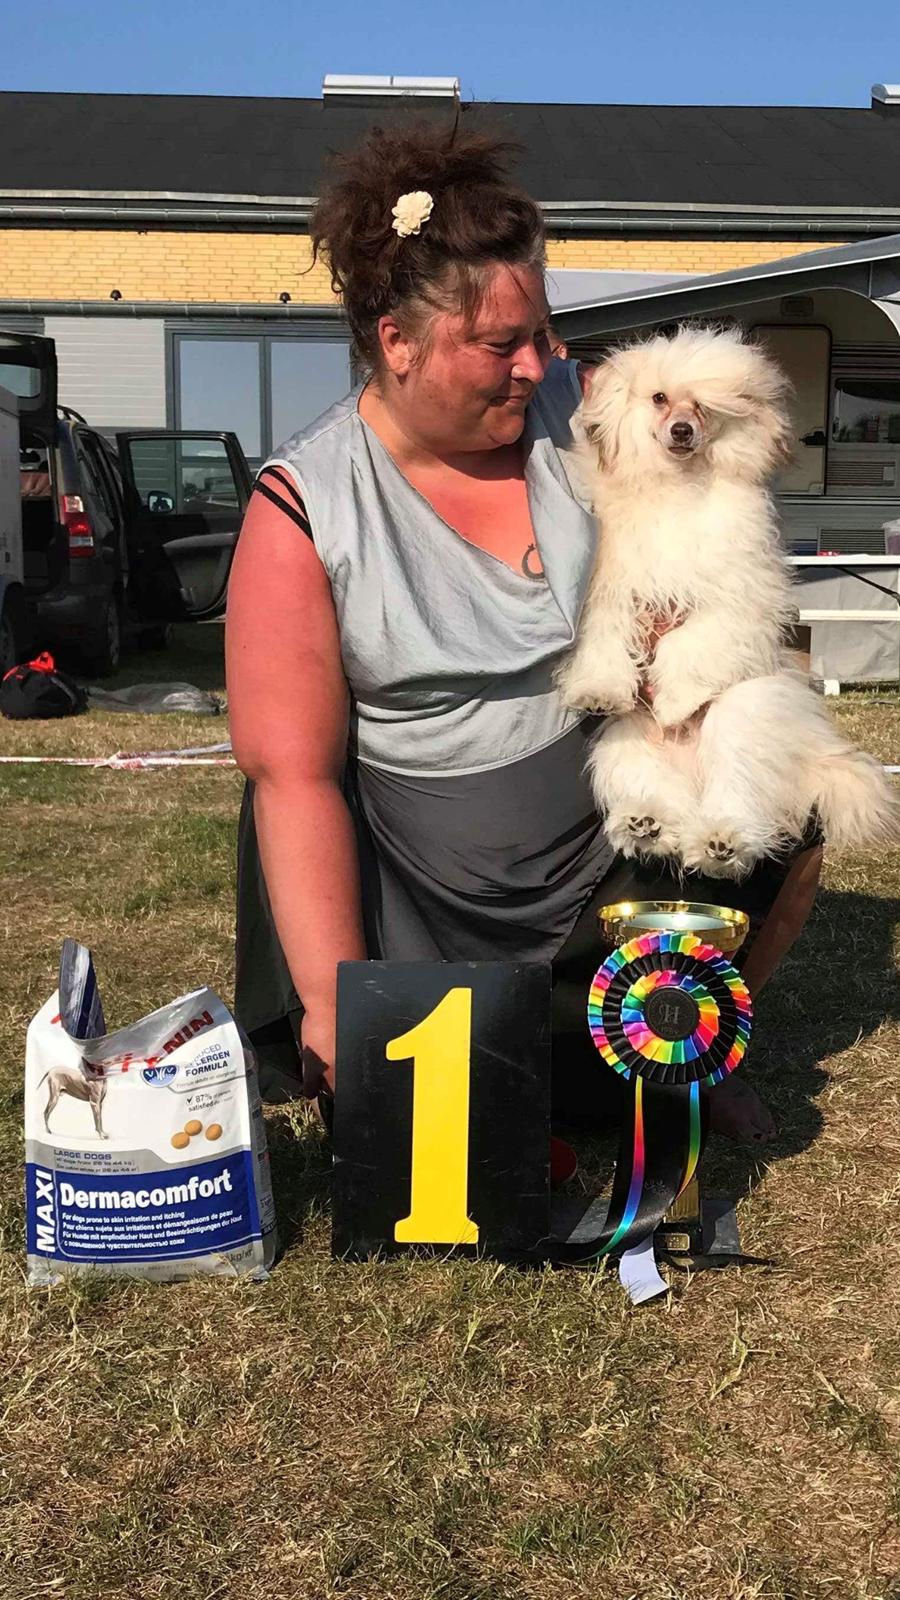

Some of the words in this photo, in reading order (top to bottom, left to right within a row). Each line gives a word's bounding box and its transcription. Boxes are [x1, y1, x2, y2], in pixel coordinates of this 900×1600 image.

[185, 1060, 228, 1076] FORMULA
[386, 988, 479, 1243] 1
[54, 1149, 81, 1159] LARGE
[60, 1168, 233, 1209] Dermacomfort
[35, 1169, 56, 1253] MAXI
[62, 1212, 72, 1221] For
[72, 1213, 85, 1223] dogs
[124, 1215, 150, 1223] irritation
[164, 1211, 185, 1220] itching
[230, 1215, 242, 1224] Haut
[63, 1221, 75, 1230] Pour
[126, 1224, 154, 1232] irritations
[219, 1210, 233, 1218] peau
